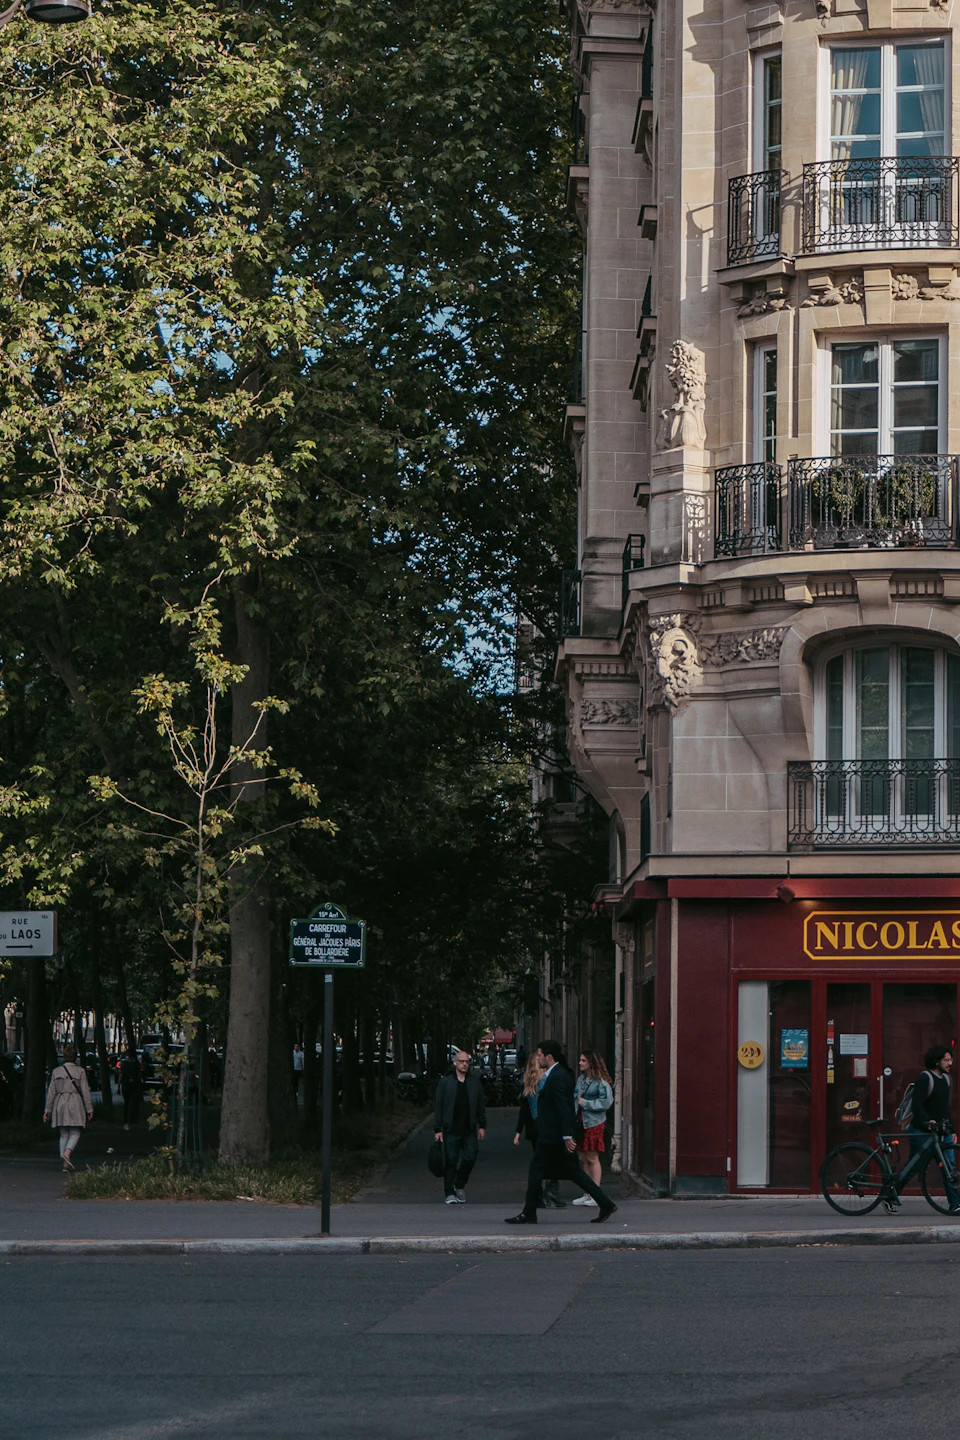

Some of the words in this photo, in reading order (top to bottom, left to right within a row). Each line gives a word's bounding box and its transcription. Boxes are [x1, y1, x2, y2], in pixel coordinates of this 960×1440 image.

[309, 923, 347, 933] CARREFOUR
[11, 929, 41, 939] LAOS
[293, 936, 317, 947] GÉNÉRAL
[318, 937, 344, 947] JACQUES
[305, 947, 313, 955] DE
